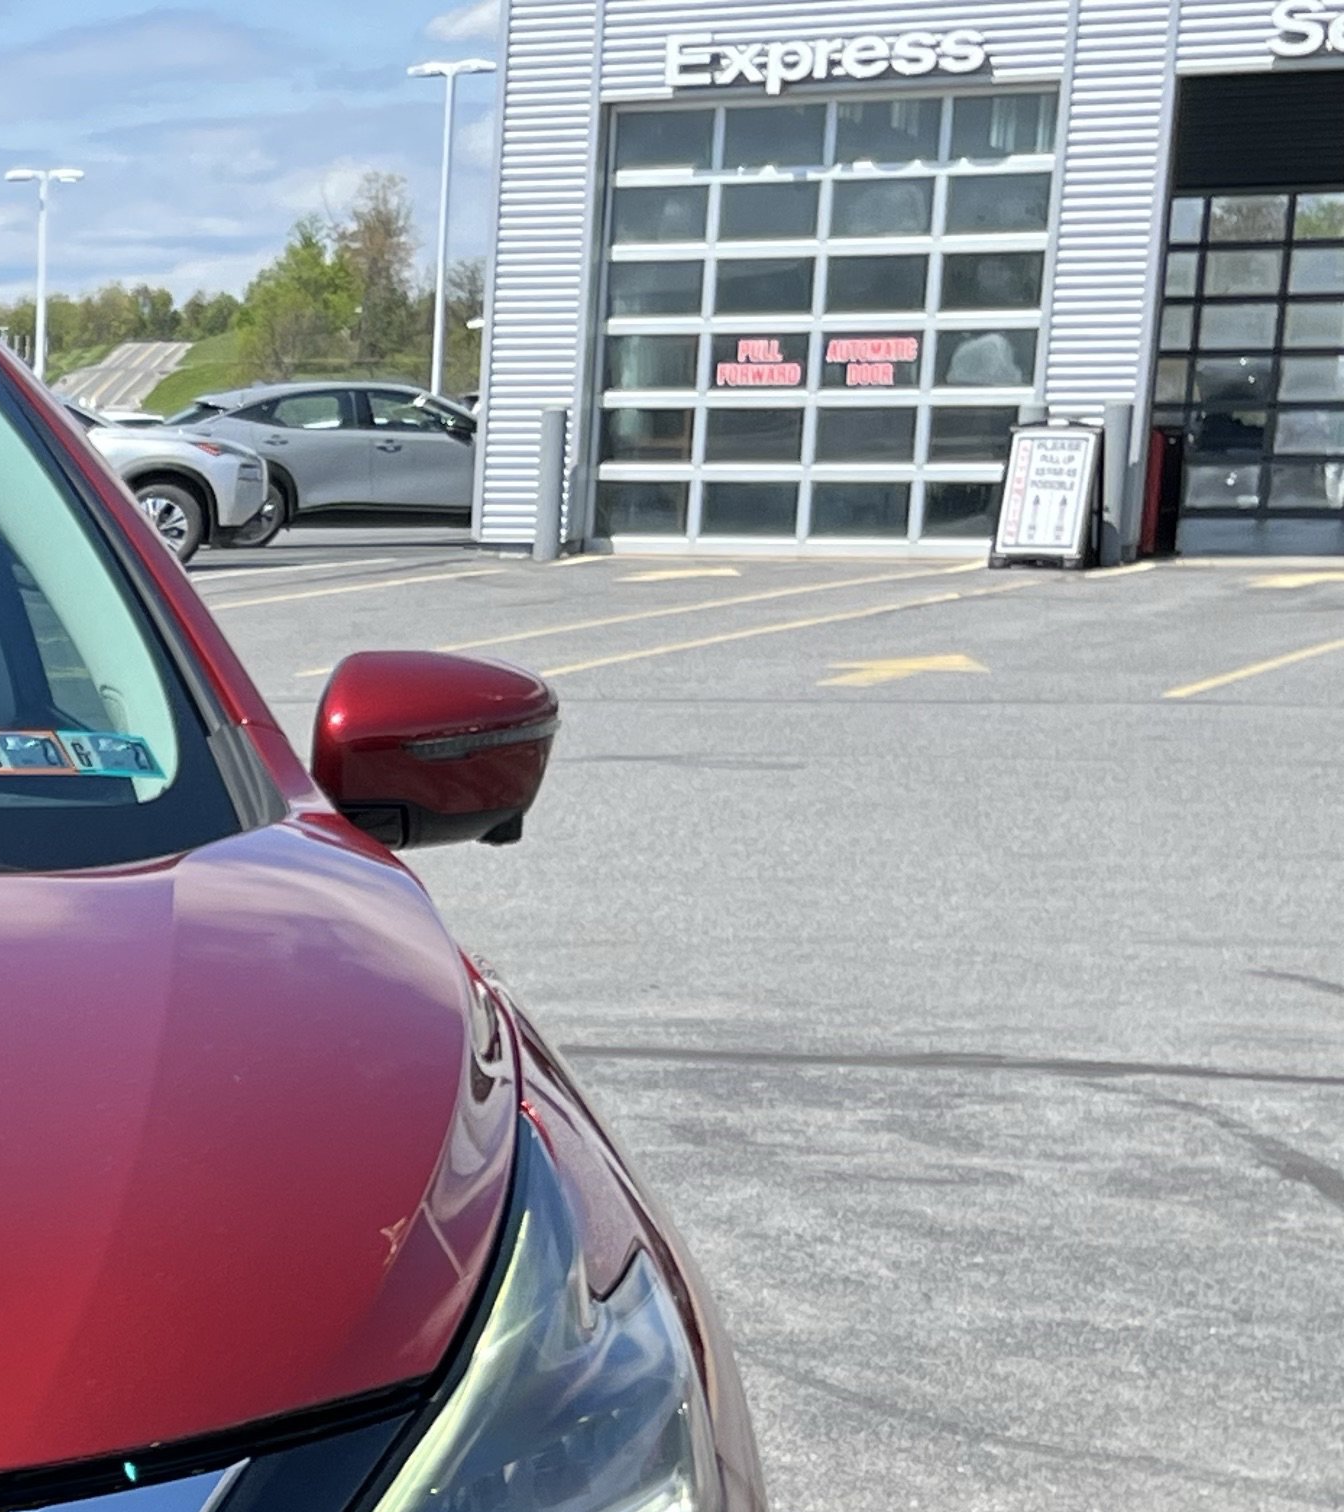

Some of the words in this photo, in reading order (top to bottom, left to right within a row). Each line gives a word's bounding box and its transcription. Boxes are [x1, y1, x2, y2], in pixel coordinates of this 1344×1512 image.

[665, 29, 986, 95] Express
[738, 339, 783, 363] PULL
[826, 337, 918, 363] AUTOMATIC
[717, 362, 801, 386] FORWARD
[846, 362, 894, 386] DOOR
